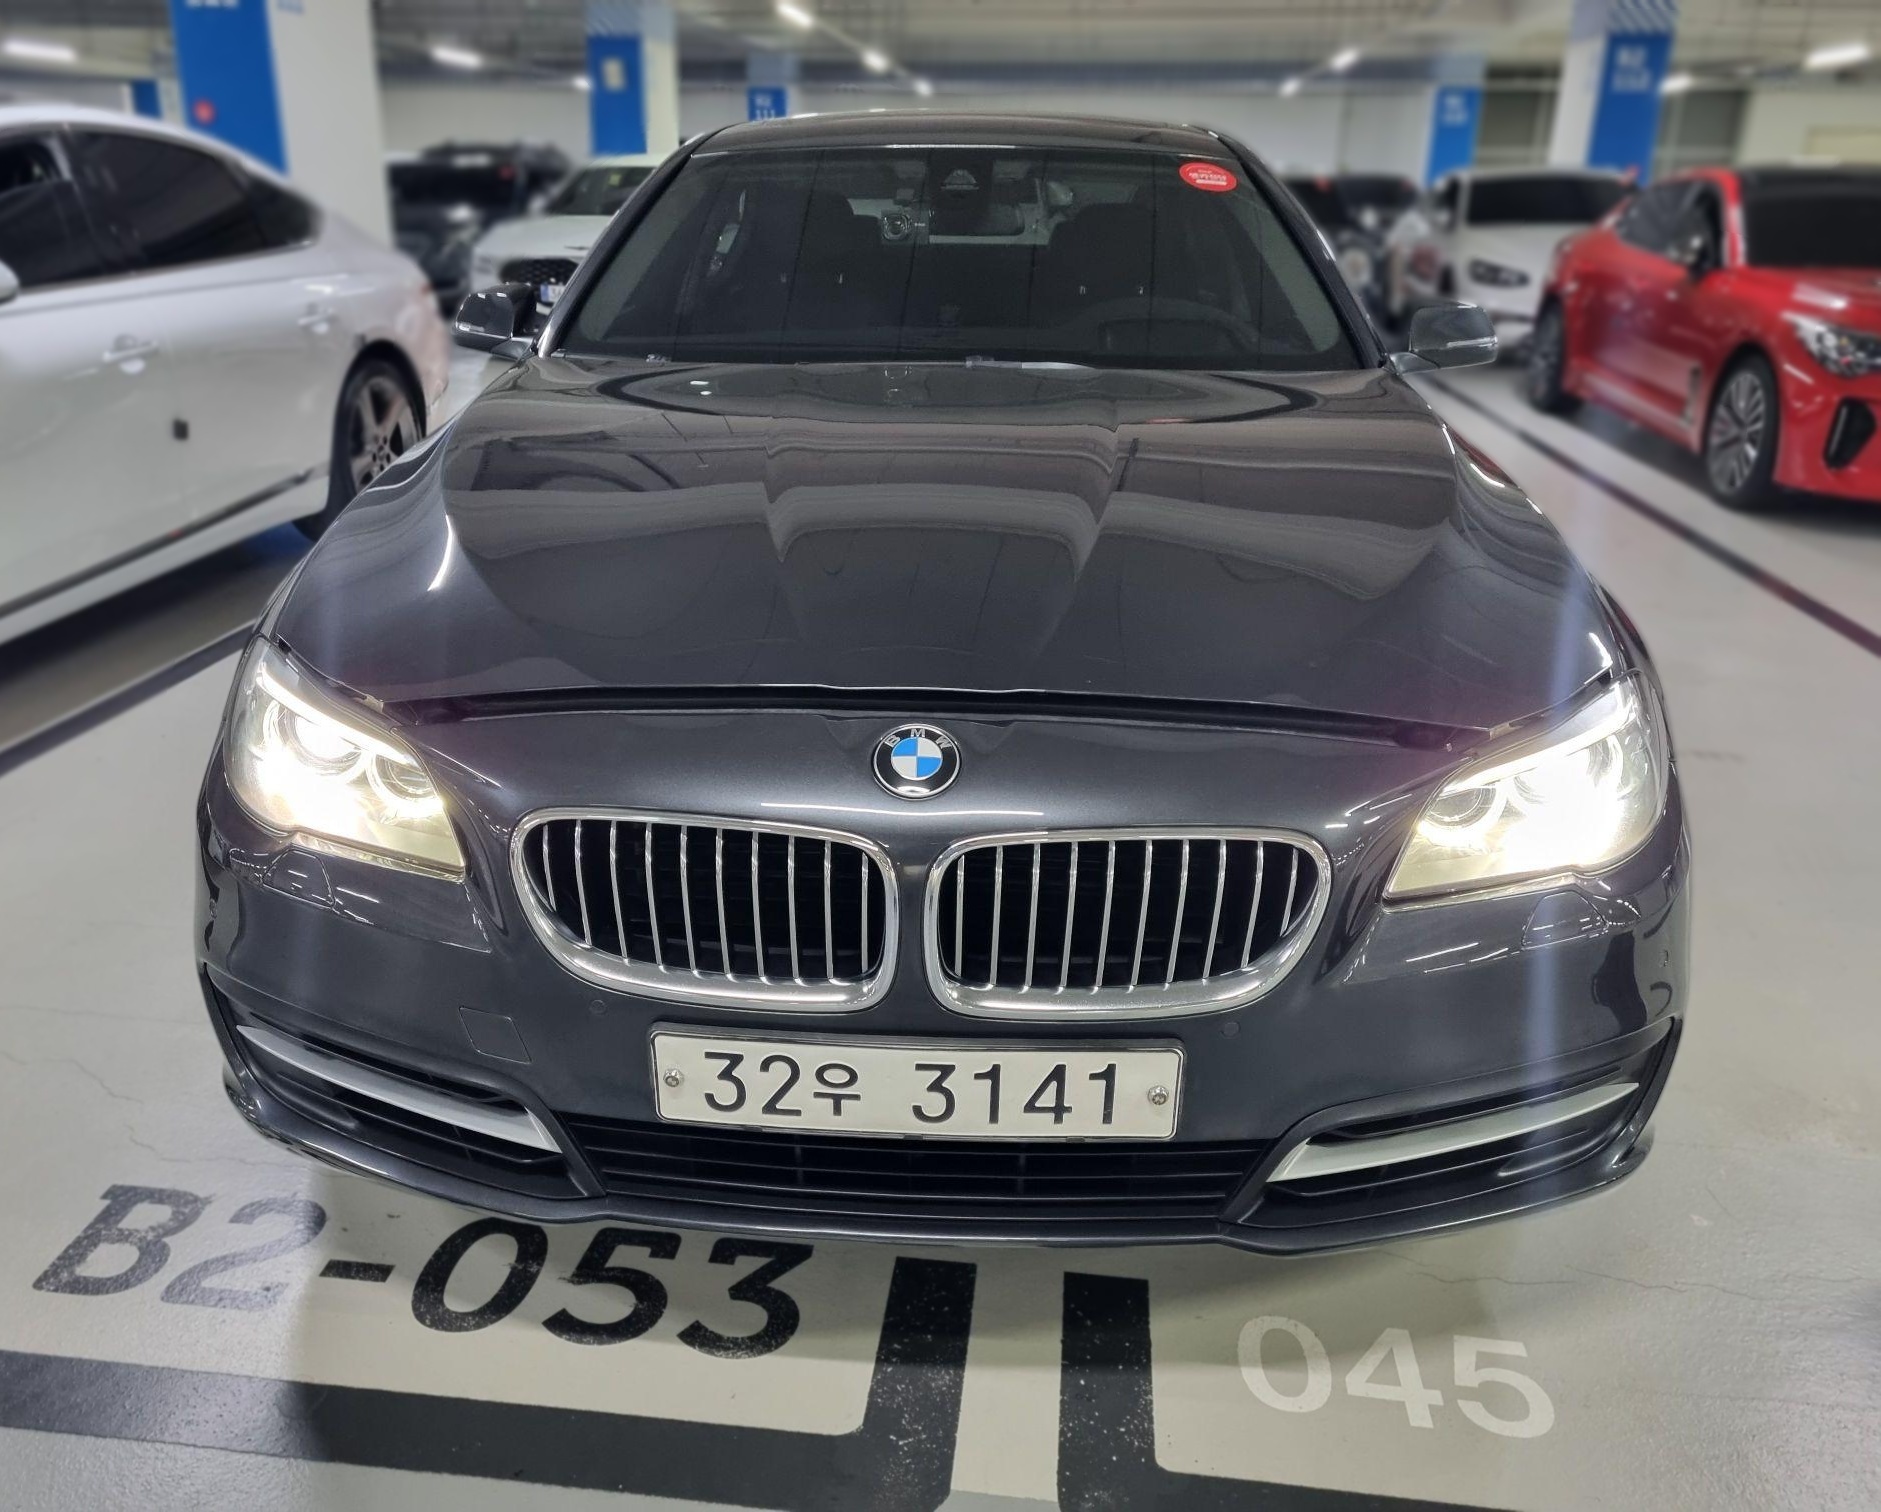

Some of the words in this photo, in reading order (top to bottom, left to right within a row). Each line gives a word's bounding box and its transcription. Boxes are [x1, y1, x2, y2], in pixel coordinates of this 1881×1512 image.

[883, 728, 953, 749] BMW
[704, 1051, 861, 1117] 32우
[911, 1063, 1117, 1125] 3141
[32, 1184, 815, 1360] B2-053
[1237, 1315, 1556, 1439] 045
